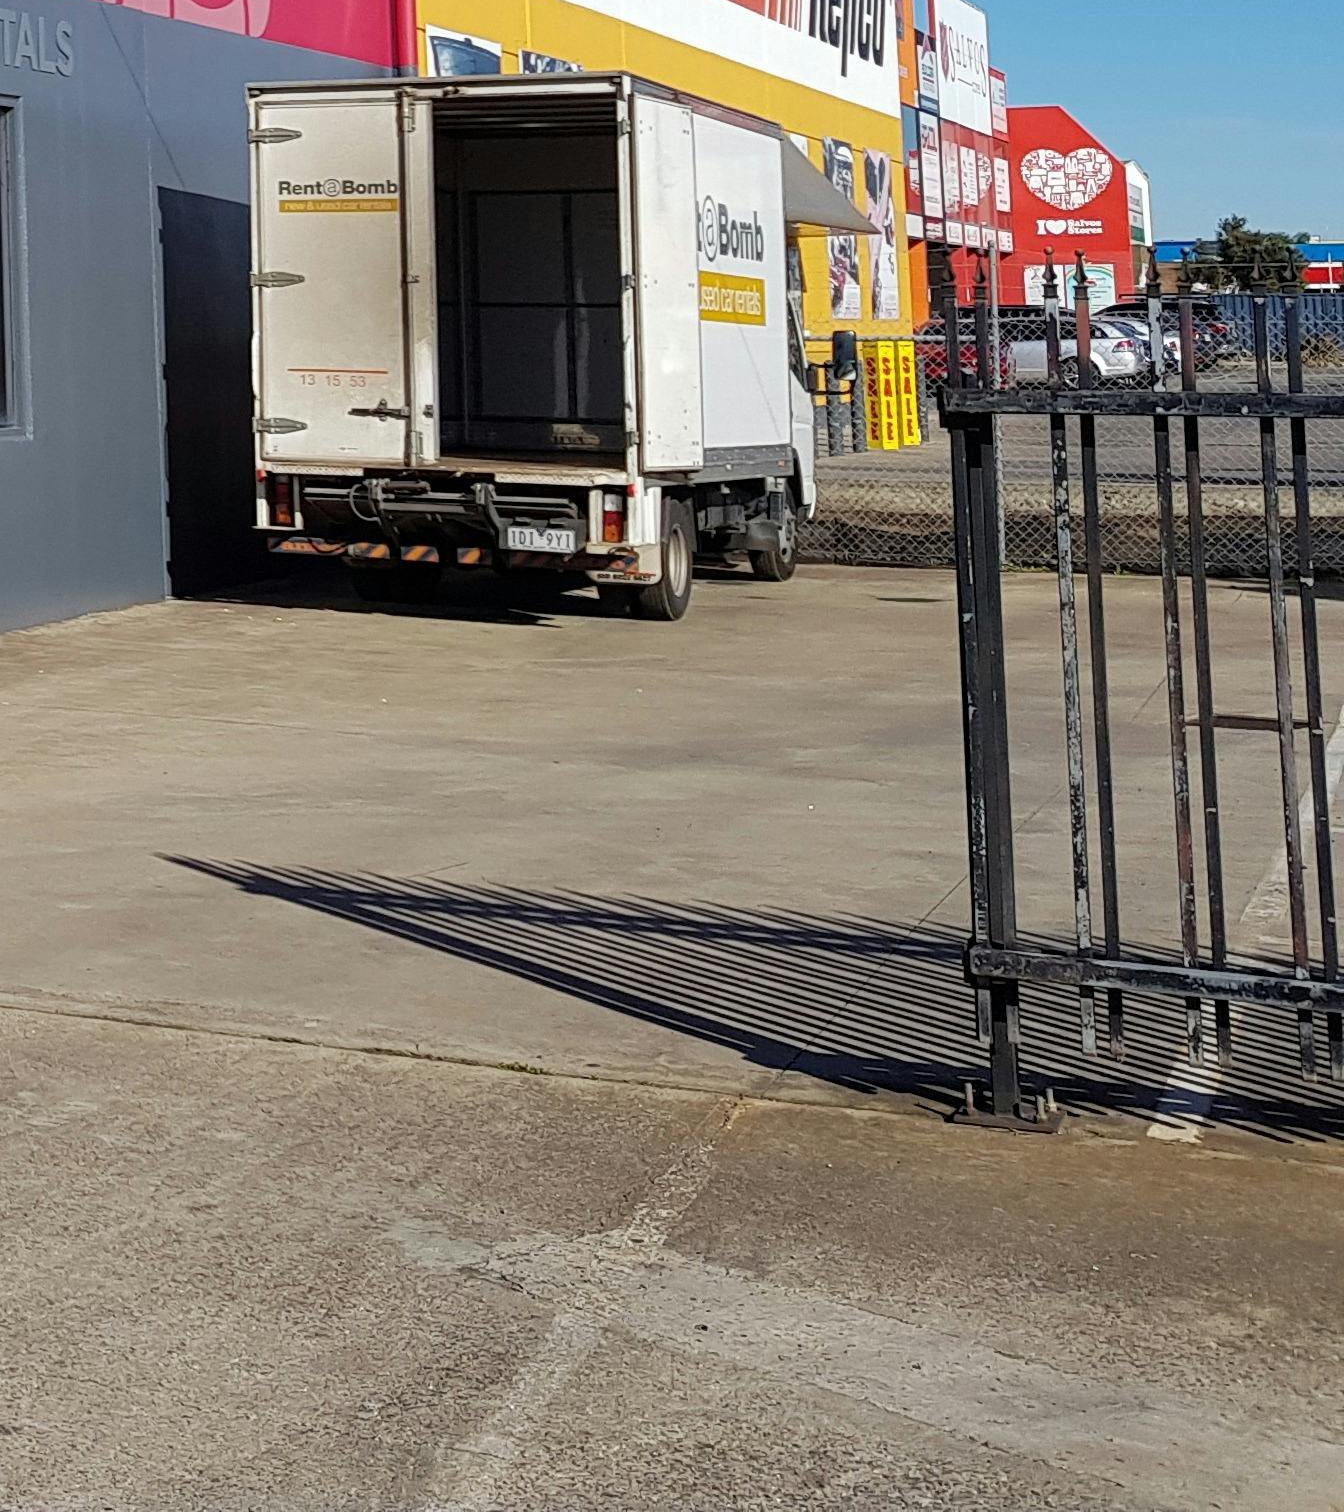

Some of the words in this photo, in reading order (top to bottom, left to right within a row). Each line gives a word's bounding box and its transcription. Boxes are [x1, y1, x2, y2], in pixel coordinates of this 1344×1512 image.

[1036, 219, 1047, 235] I
[300, 374, 316, 386] 13
[326, 375, 341, 387] 15
[349, 376, 366, 388] 53
